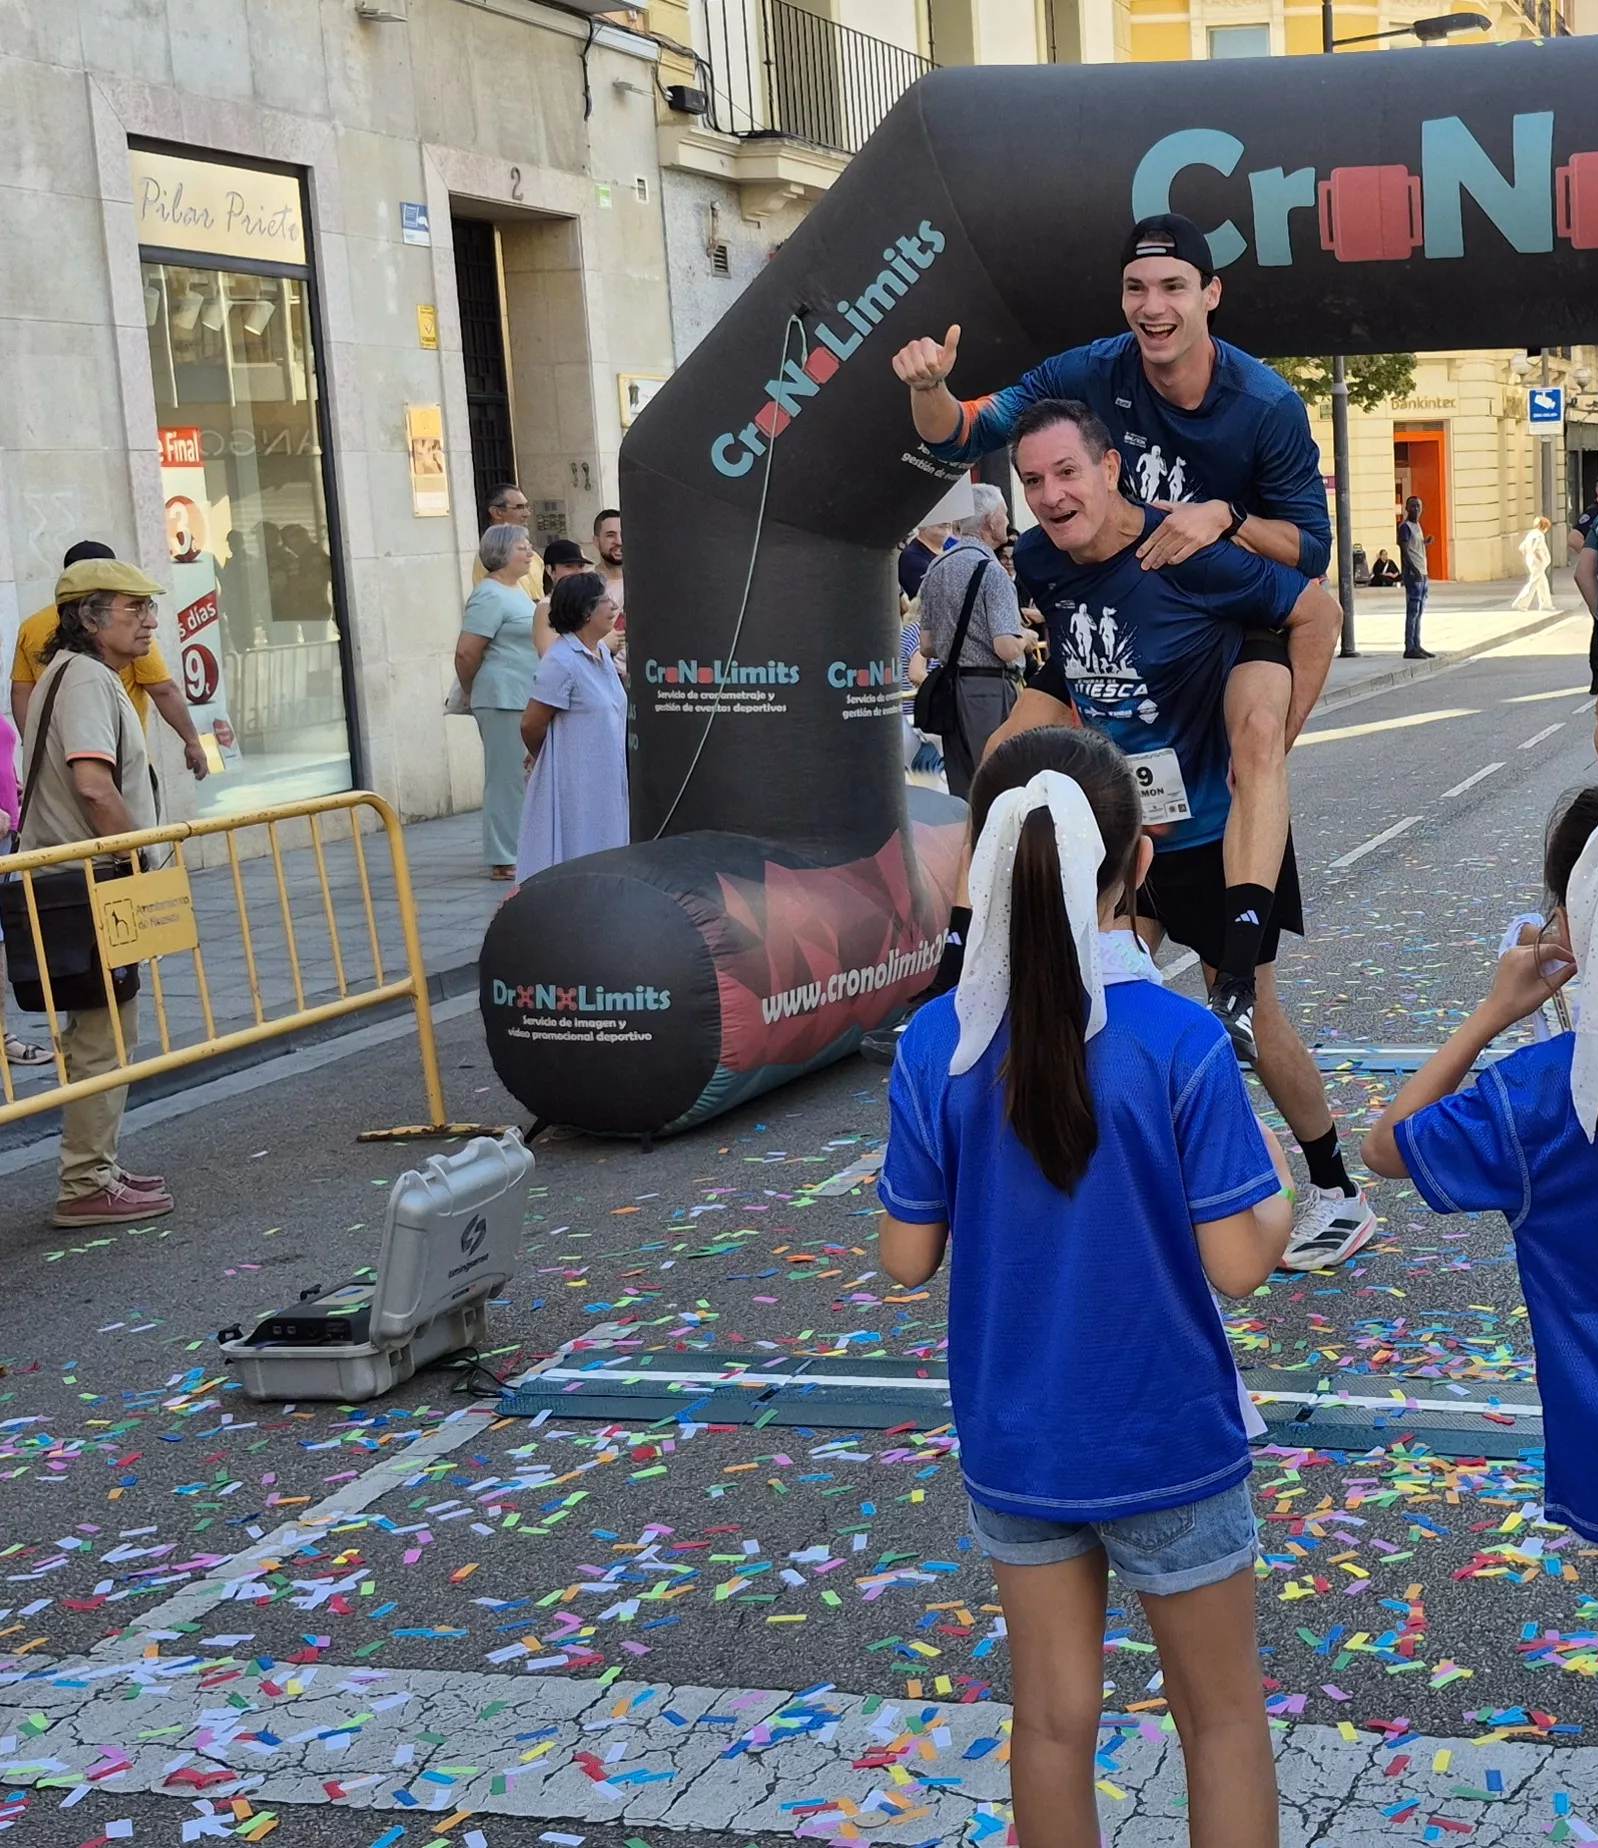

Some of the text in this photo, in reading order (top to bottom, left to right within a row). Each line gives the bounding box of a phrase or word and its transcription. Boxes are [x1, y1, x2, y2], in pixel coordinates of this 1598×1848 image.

[510, 166, 524, 201] 2
[139, 177, 299, 242] Pilar Prieto
[165, 430, 201, 463] Final
[186, 600, 218, 631] días
[657, 689, 686, 699] Servicio
[687, 689, 699, 699] de
[767, 691, 776, 701] y
[682, 702, 693, 712] de
[732, 702, 787, 713] deportivos
[1135, 766, 1154, 787] 9
[1139, 787, 1165, 797] MON
[522, 1014, 627, 1030] Servicio de imagen y
[532, 1030, 594, 1042] promocional
[596, 1031, 653, 1043] deportivo
